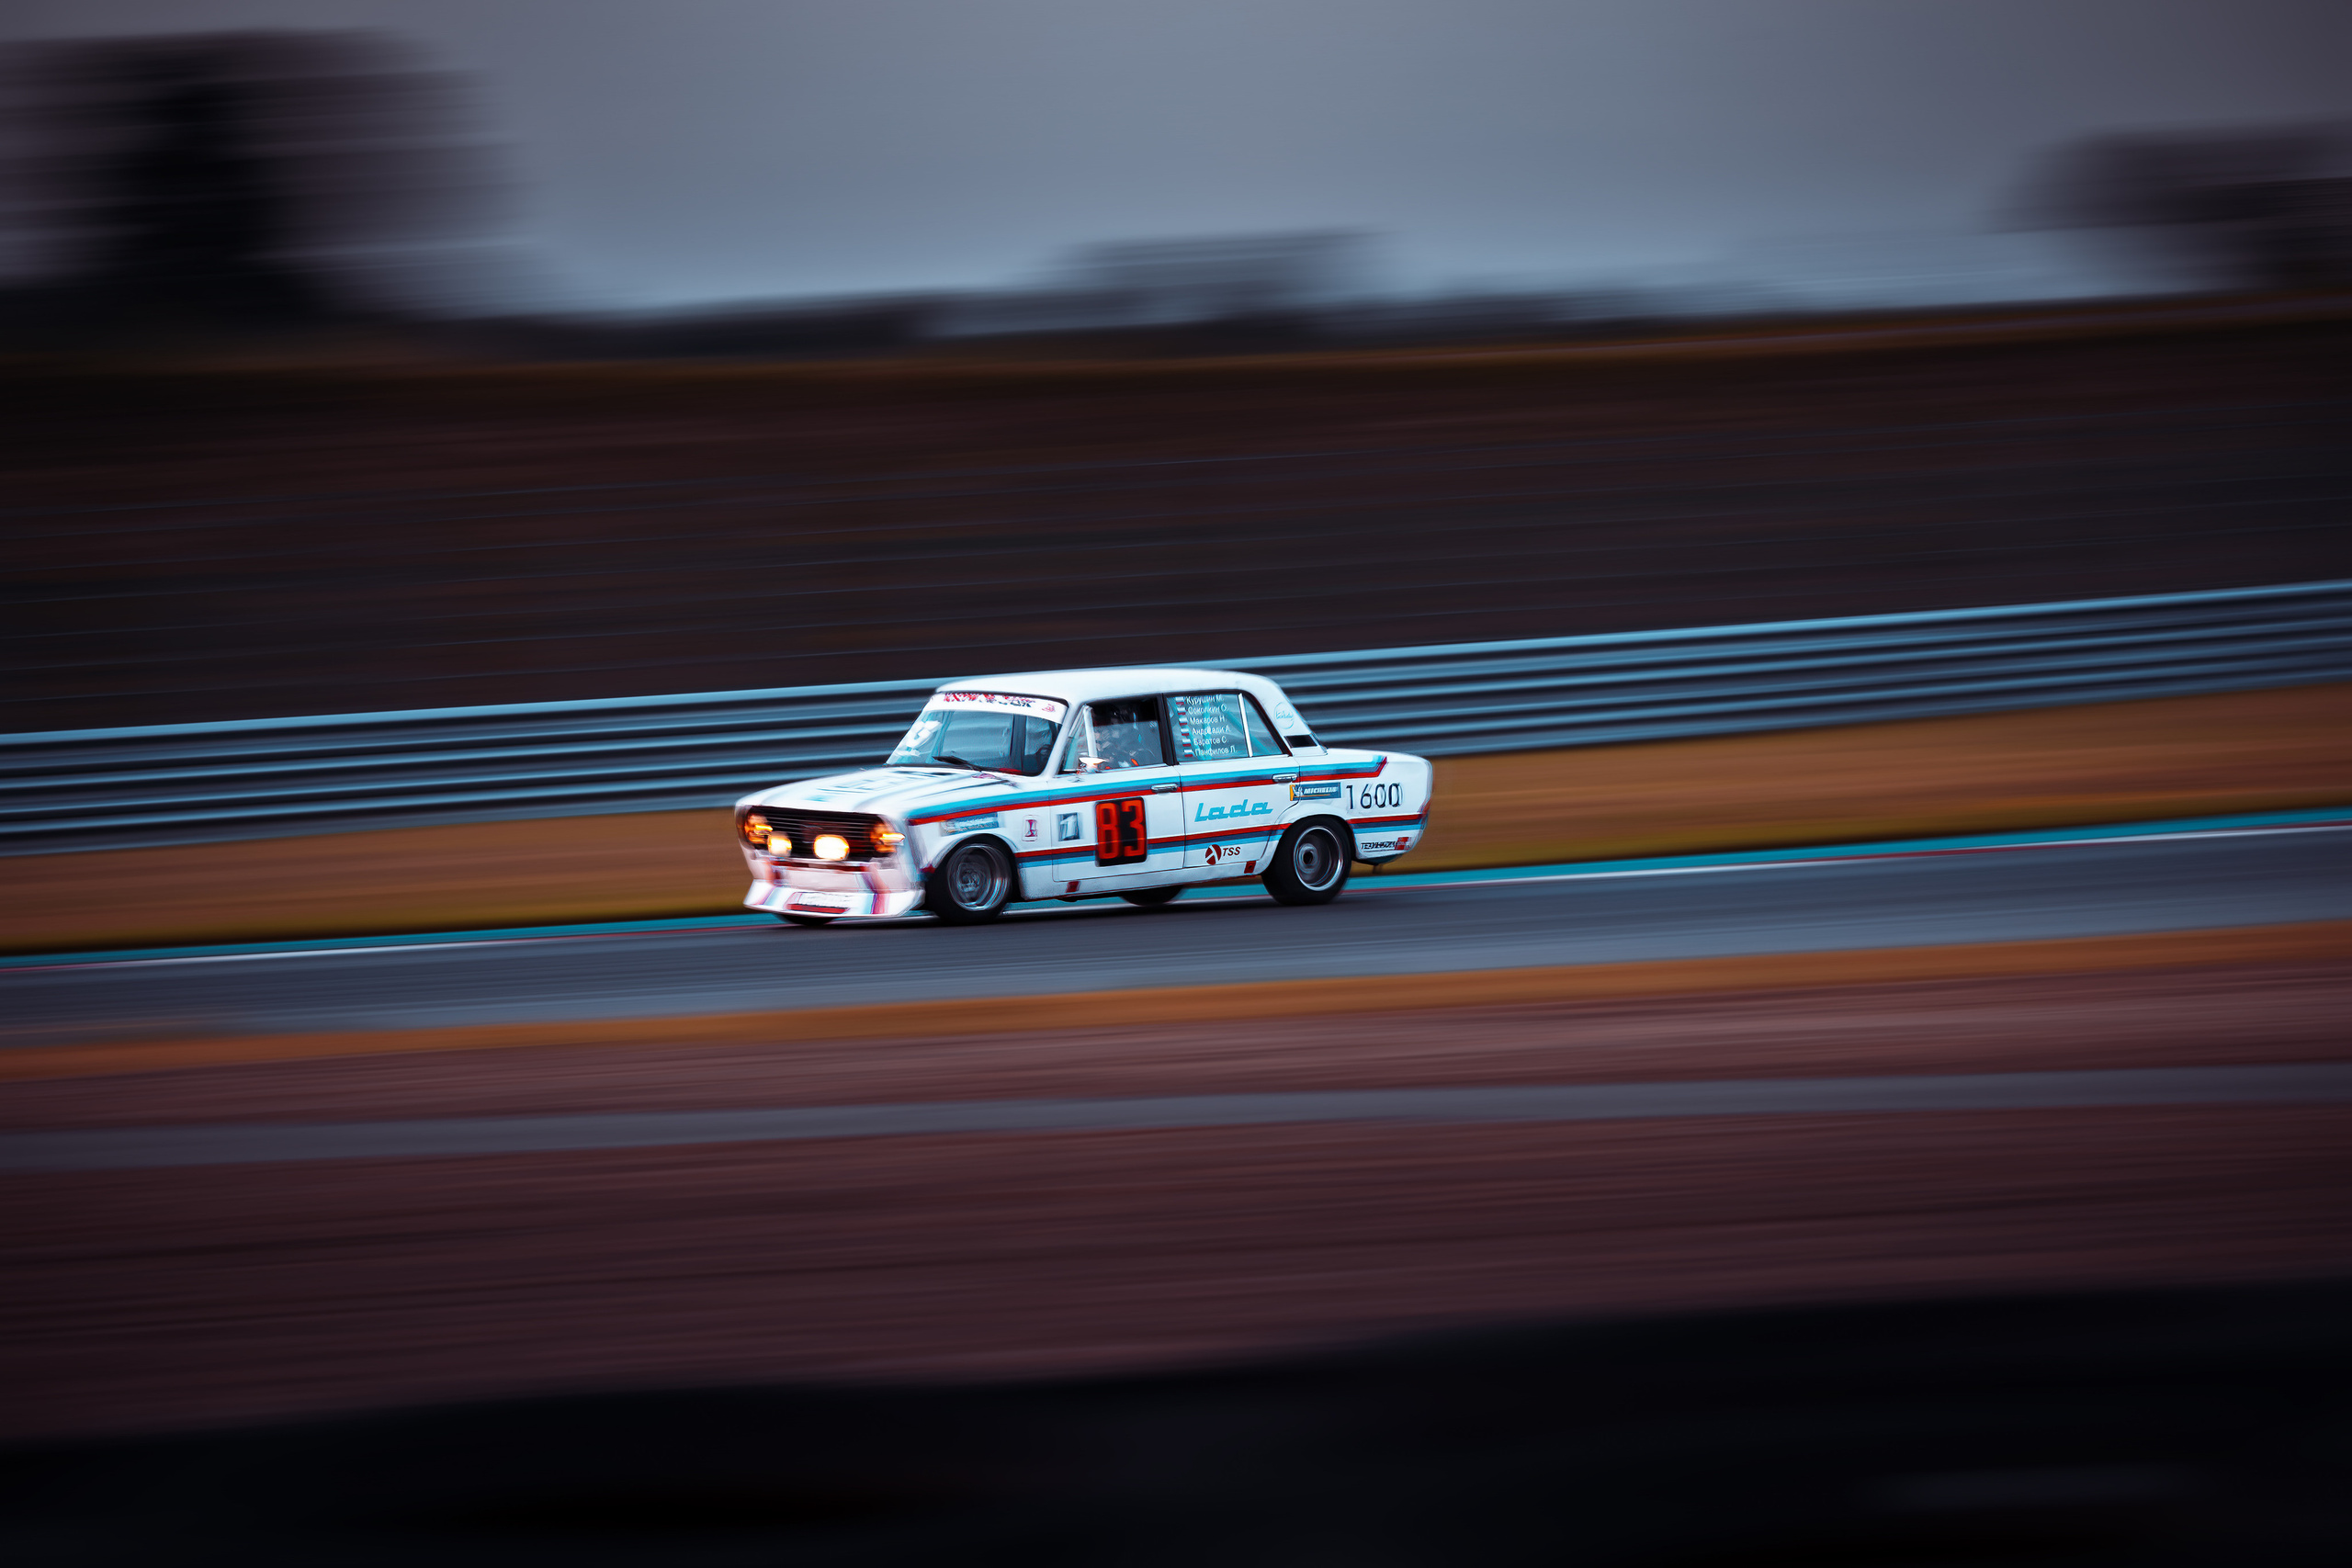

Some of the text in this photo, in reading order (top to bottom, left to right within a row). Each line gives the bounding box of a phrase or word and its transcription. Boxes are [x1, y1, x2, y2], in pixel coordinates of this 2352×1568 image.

[1346, 783, 1402, 809] 1600
[1194, 799, 1273, 822] Lada
[1096, 799, 1146, 860] 83
[1223, 846, 1241, 857] TSS
